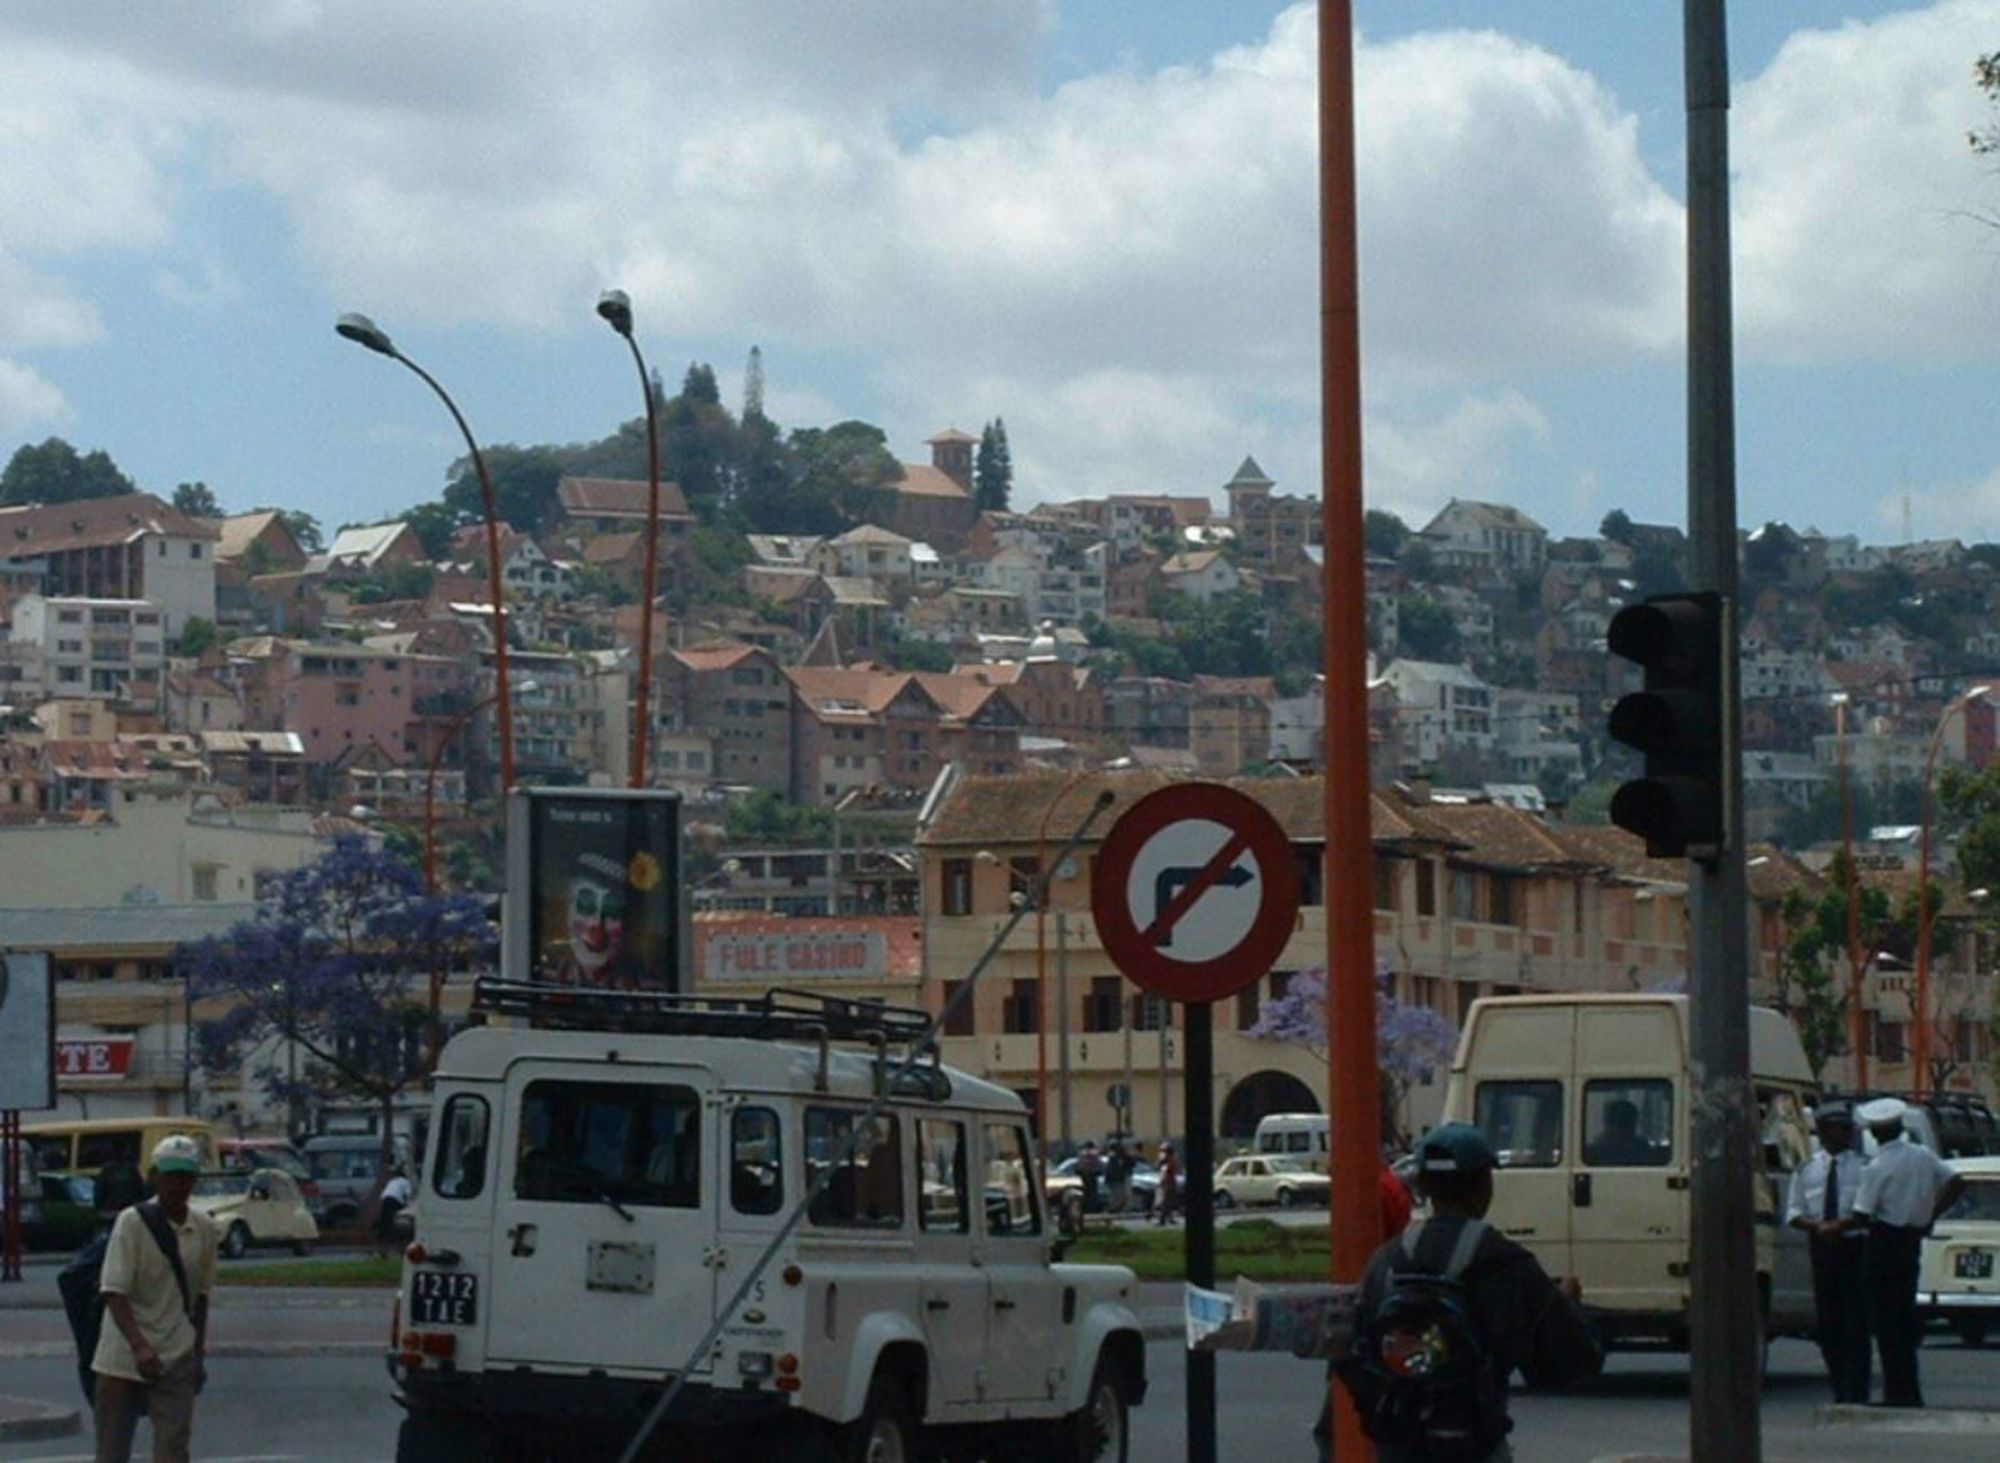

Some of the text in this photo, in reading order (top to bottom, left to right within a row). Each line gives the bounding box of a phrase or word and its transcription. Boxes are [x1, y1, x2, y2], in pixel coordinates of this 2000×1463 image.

[55, 1044, 111, 1073] TE
[418, 1273, 474, 1298] 1212
[424, 1299, 467, 1323] TAE
